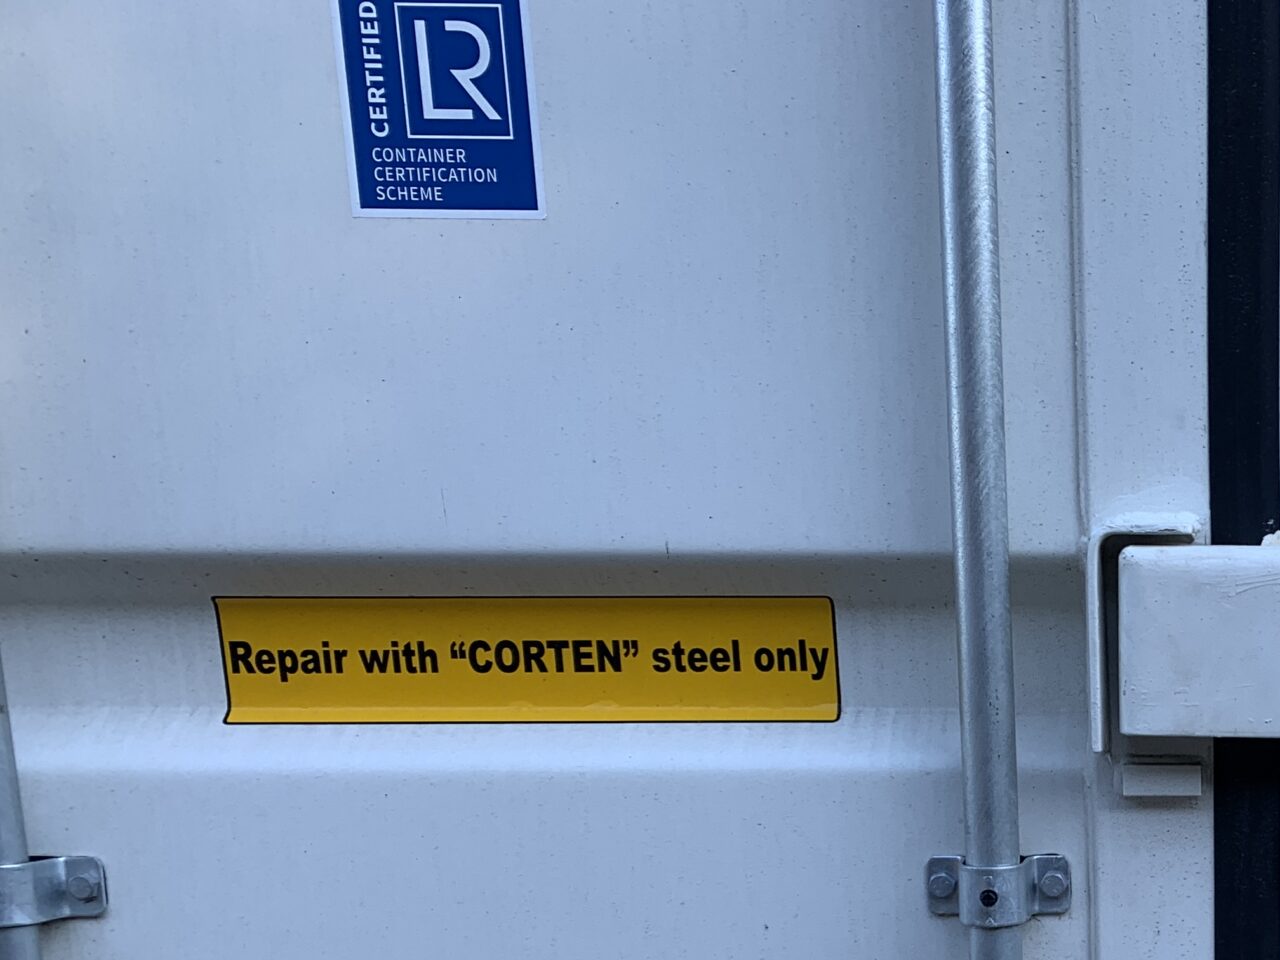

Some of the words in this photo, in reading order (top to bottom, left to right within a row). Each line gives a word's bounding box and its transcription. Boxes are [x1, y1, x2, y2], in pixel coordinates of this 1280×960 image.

[359, 1, 389, 138] CERTIFIED
[414, 19, 503, 120] LR
[372, 147, 467, 163] CONTAINER
[374, 166, 498, 183] CERTIFICATION
[376, 185, 444, 201] SCHEME
[228, 640, 349, 682] Repair
[359, 640, 440, 675] with
[652, 639, 742, 673] steel
[754, 638, 830, 681] only
